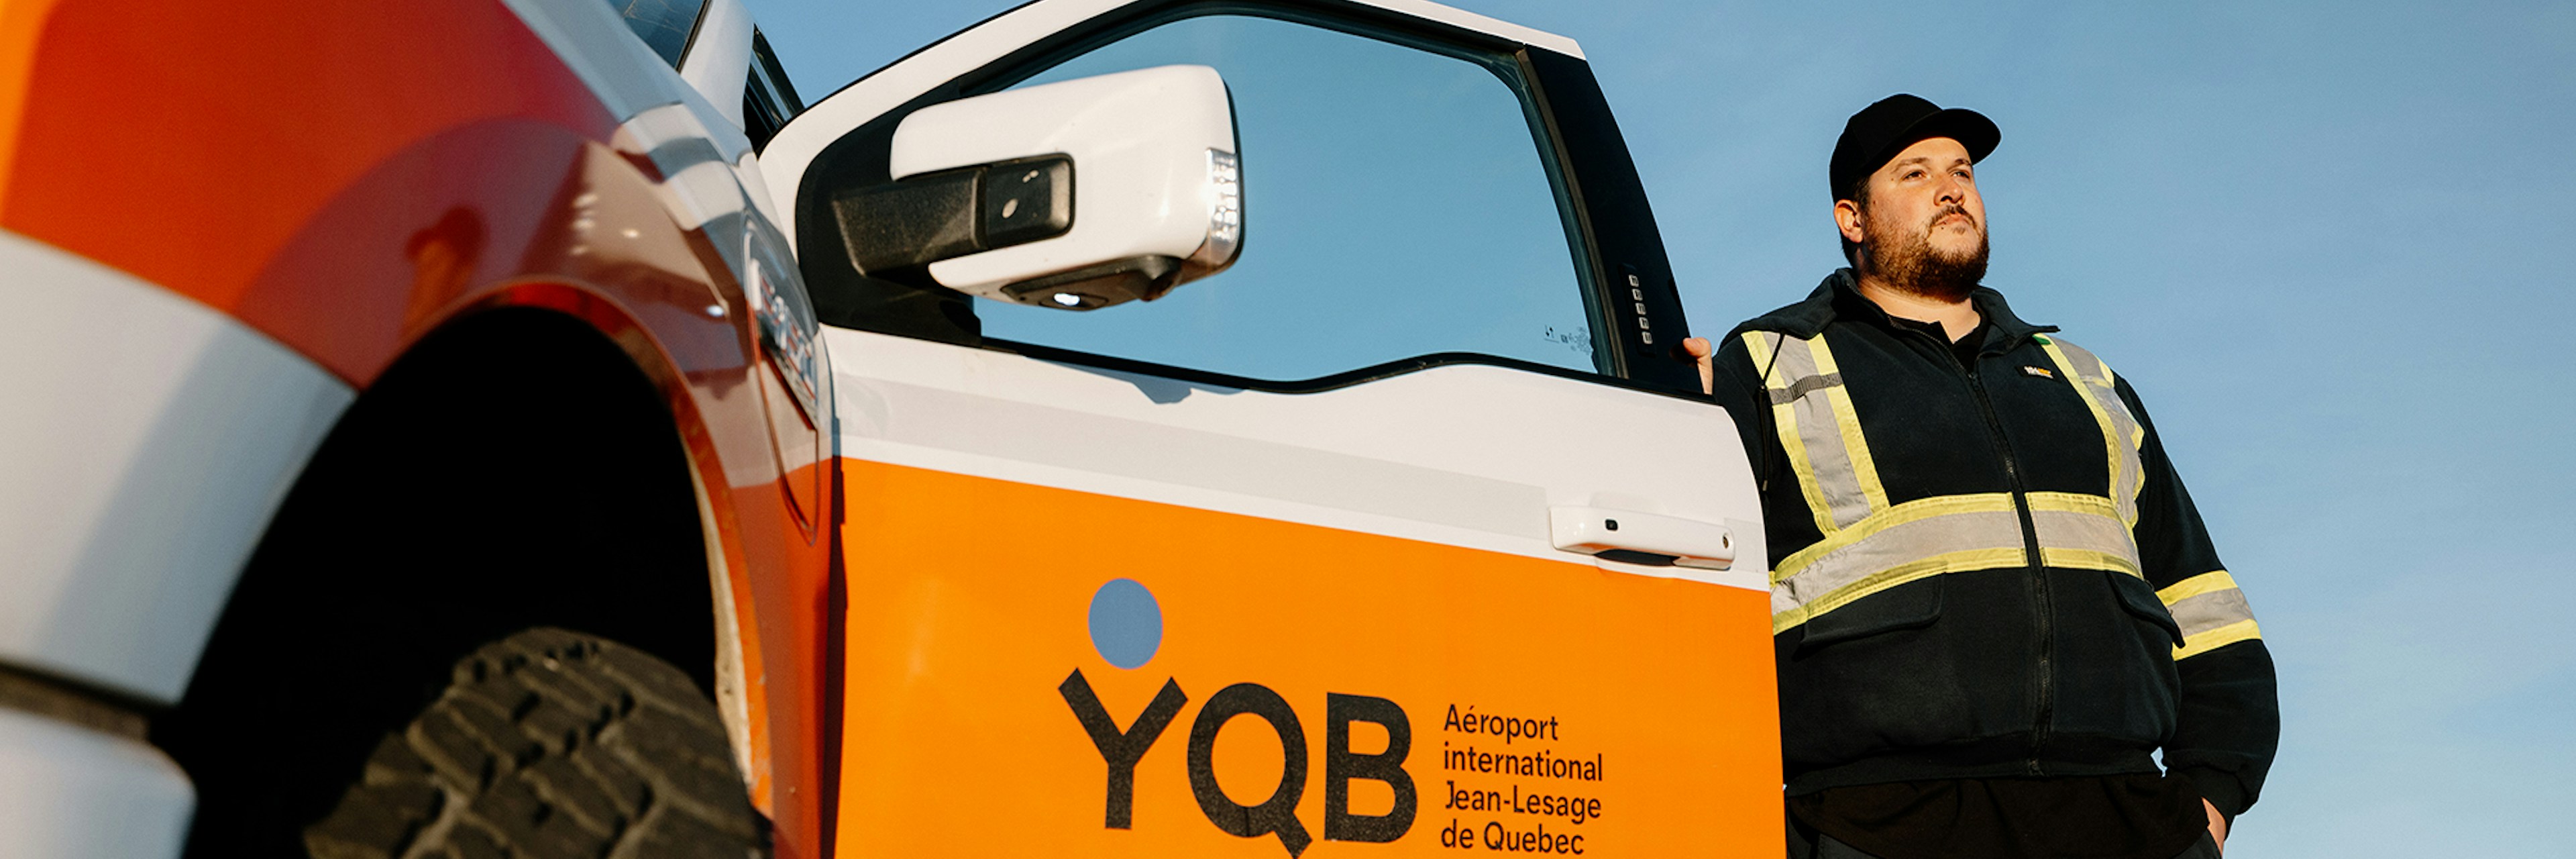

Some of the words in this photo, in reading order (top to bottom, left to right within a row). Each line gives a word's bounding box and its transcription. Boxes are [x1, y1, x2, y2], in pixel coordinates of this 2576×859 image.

[1444, 703, 1558, 744] Aéroport
[1058, 667, 1417, 859] YQB
[1444, 741, 1603, 781] international
[1445, 780, 1601, 825] Jean-Lesage
[1441, 818, 1474, 849] de
[1483, 821, 1585, 855] Quebec
